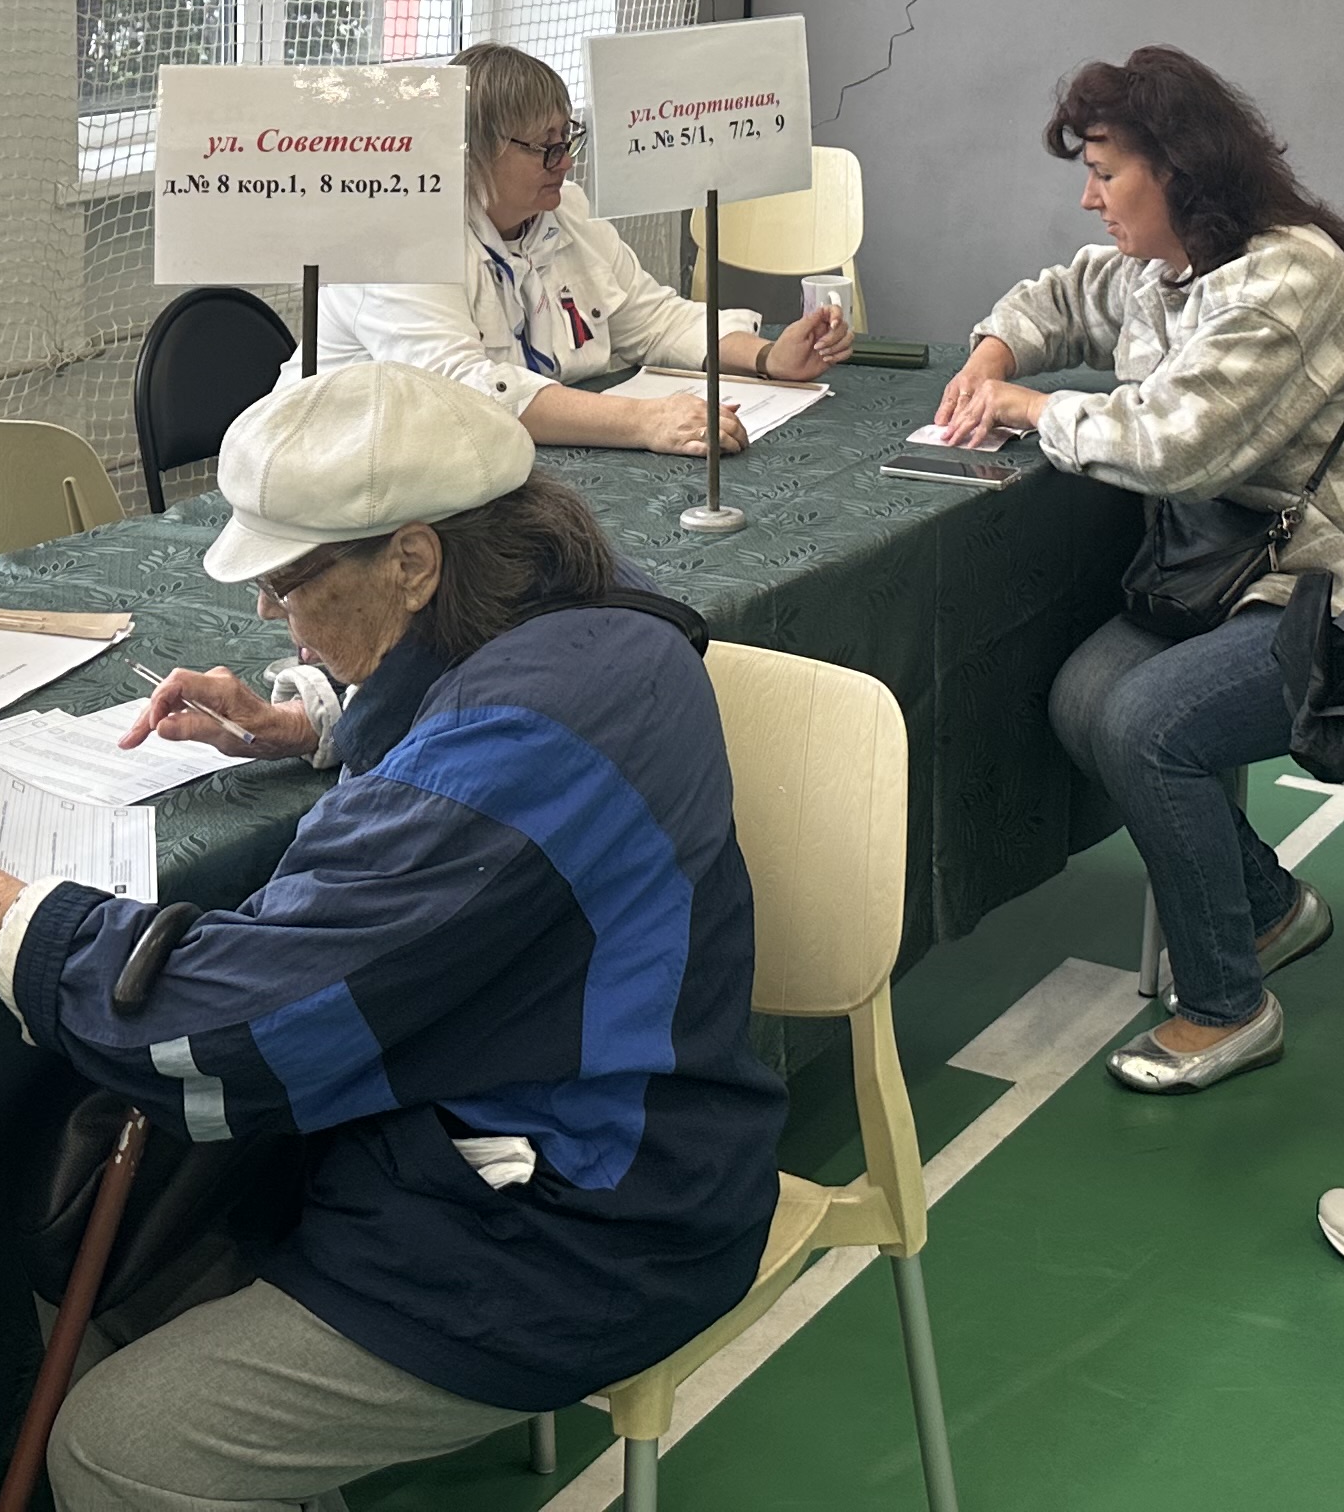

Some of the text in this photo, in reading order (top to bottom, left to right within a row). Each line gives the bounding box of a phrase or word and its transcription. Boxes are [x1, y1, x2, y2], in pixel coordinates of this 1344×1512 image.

[628, 92, 780, 128] ул.Спортивная,
[203, 128, 413, 159] ул. Советская
[628, 114, 785, 156] д. № 5/1, 7/2, 9
[162, 174, 441, 198] д.№ 8 кор.1, 8 кор.2, 12
